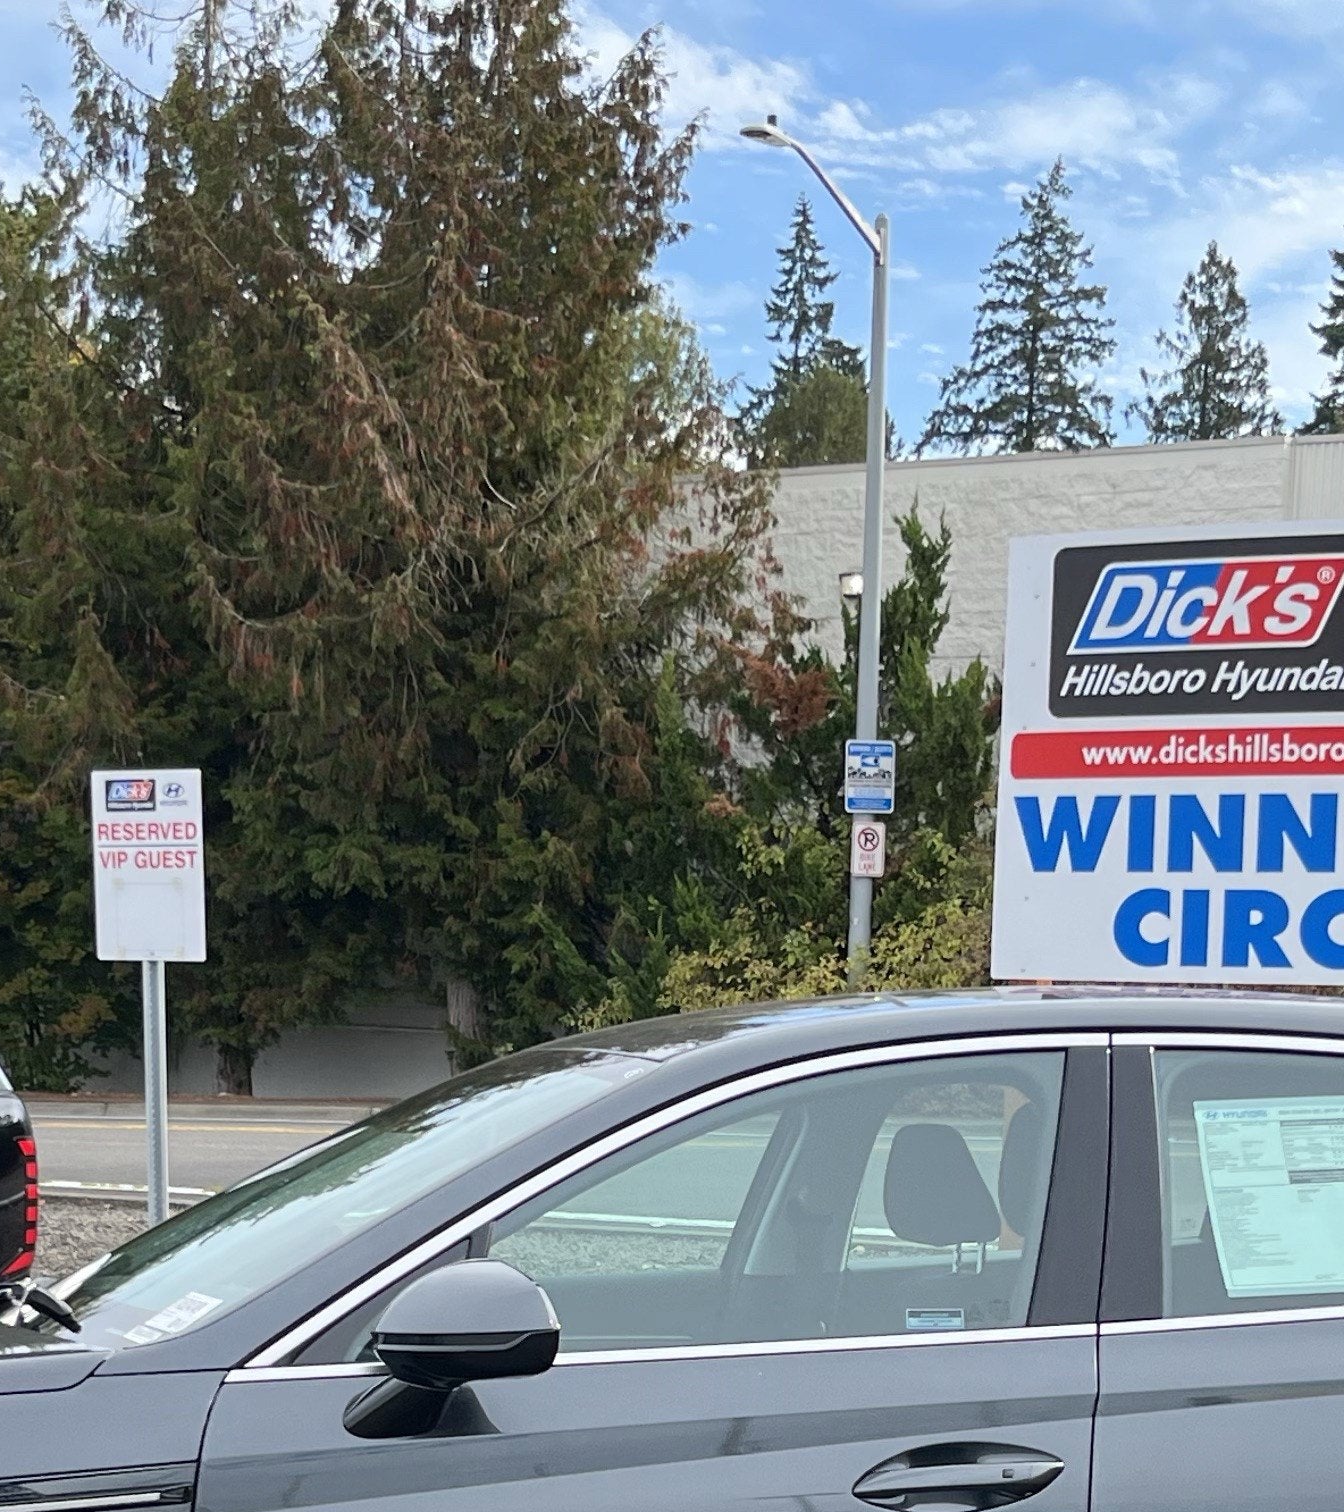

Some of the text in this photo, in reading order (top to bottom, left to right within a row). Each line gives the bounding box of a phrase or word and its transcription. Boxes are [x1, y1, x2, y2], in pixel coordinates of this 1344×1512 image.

[1088, 565, 1320, 641] Dick's
[1060, 662, 1207, 698] Hillsboro
[98, 822, 198, 841] RESERVED
[99, 850, 198, 869] VIP GUEST
